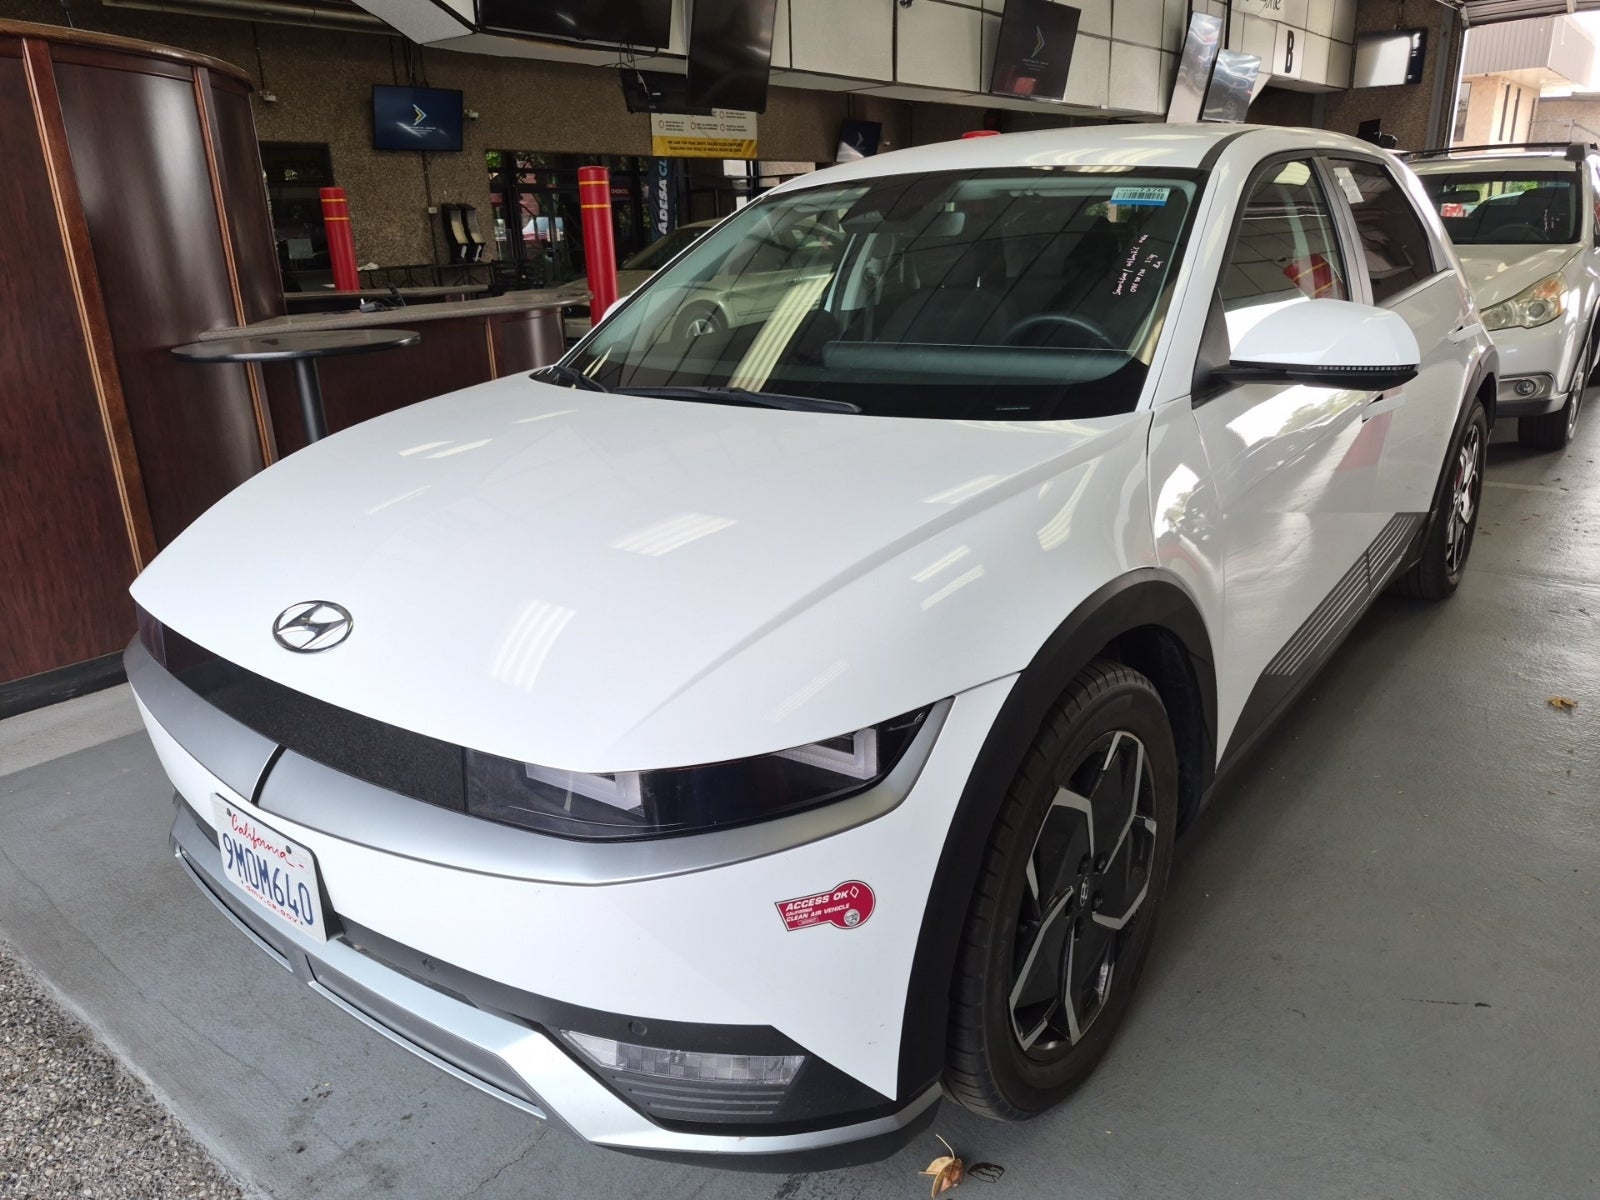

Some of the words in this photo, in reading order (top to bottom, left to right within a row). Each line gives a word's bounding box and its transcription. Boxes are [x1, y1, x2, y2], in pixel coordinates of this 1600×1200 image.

[1284, 29, 1295, 74] B
[657, 179, 669, 235] ADESA
[231, 813, 295, 868] California
[222, 832, 314, 926] 9MOM640
[785, 894, 830, 912] ACCESS
[832, 889, 849, 901] OK
[786, 912, 809, 923] CLEAN
[810, 909, 822, 918] AIR
[823, 902, 850, 915] VEHICLE
